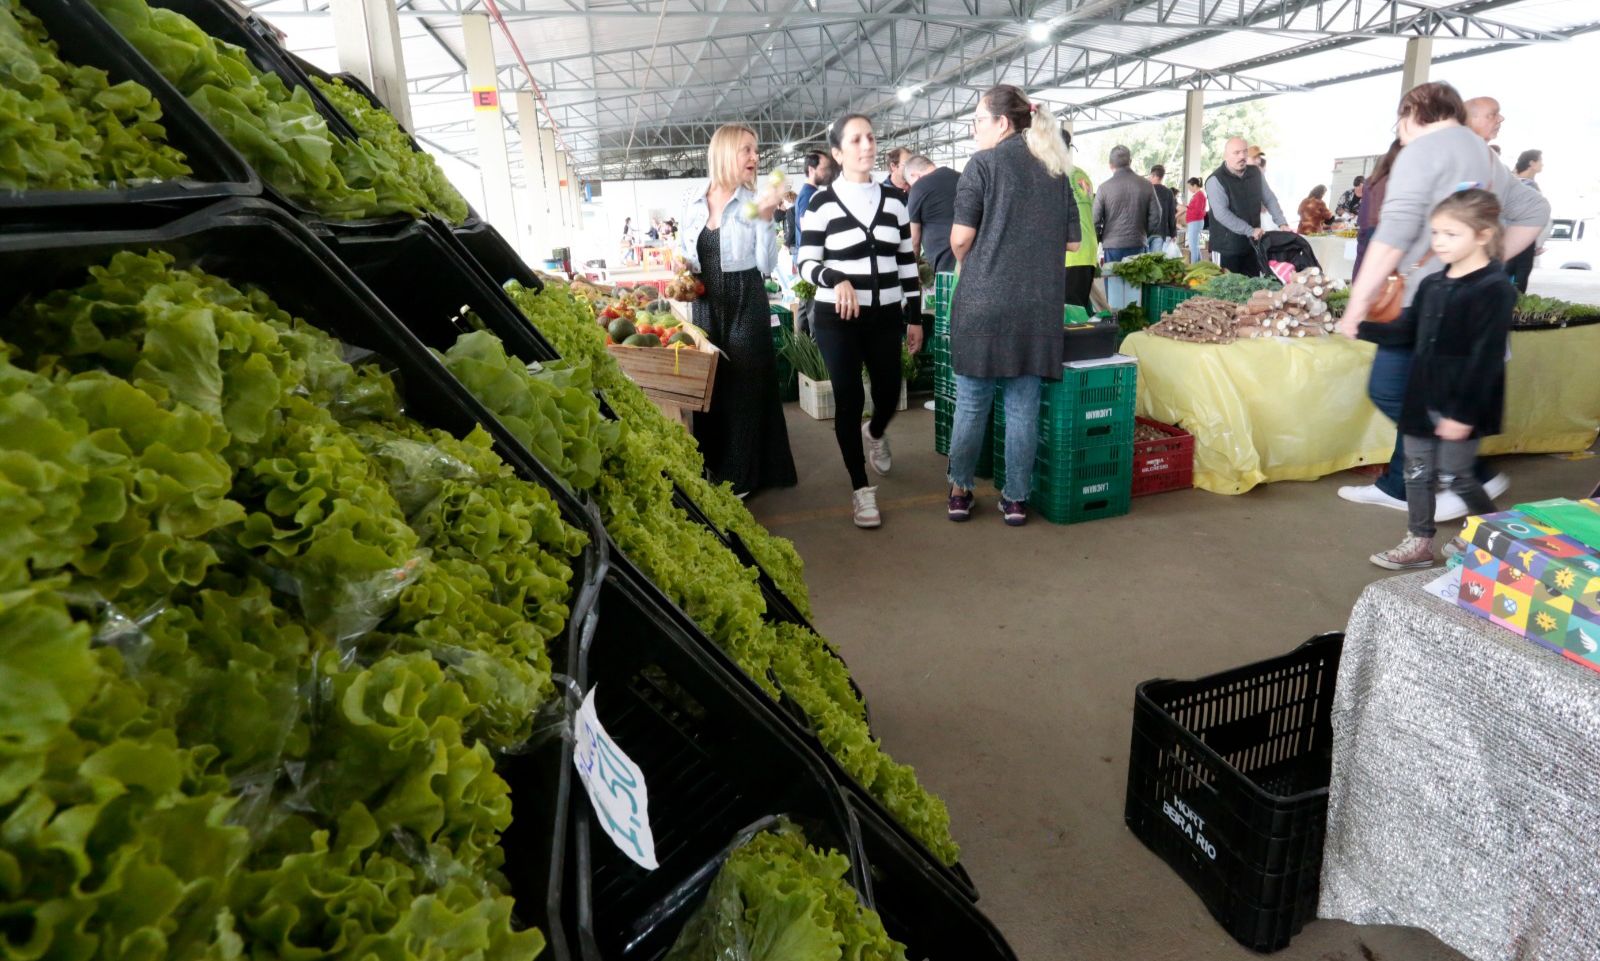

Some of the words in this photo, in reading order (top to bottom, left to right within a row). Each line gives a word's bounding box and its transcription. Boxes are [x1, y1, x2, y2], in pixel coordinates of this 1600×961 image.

[479, 91, 492, 106] E
[594, 733, 645, 858] 1,50
[1173, 794, 1206, 831] HORT
[1162, 800, 1194, 840] BEIRA
[1195, 832, 1217, 861] RIO
